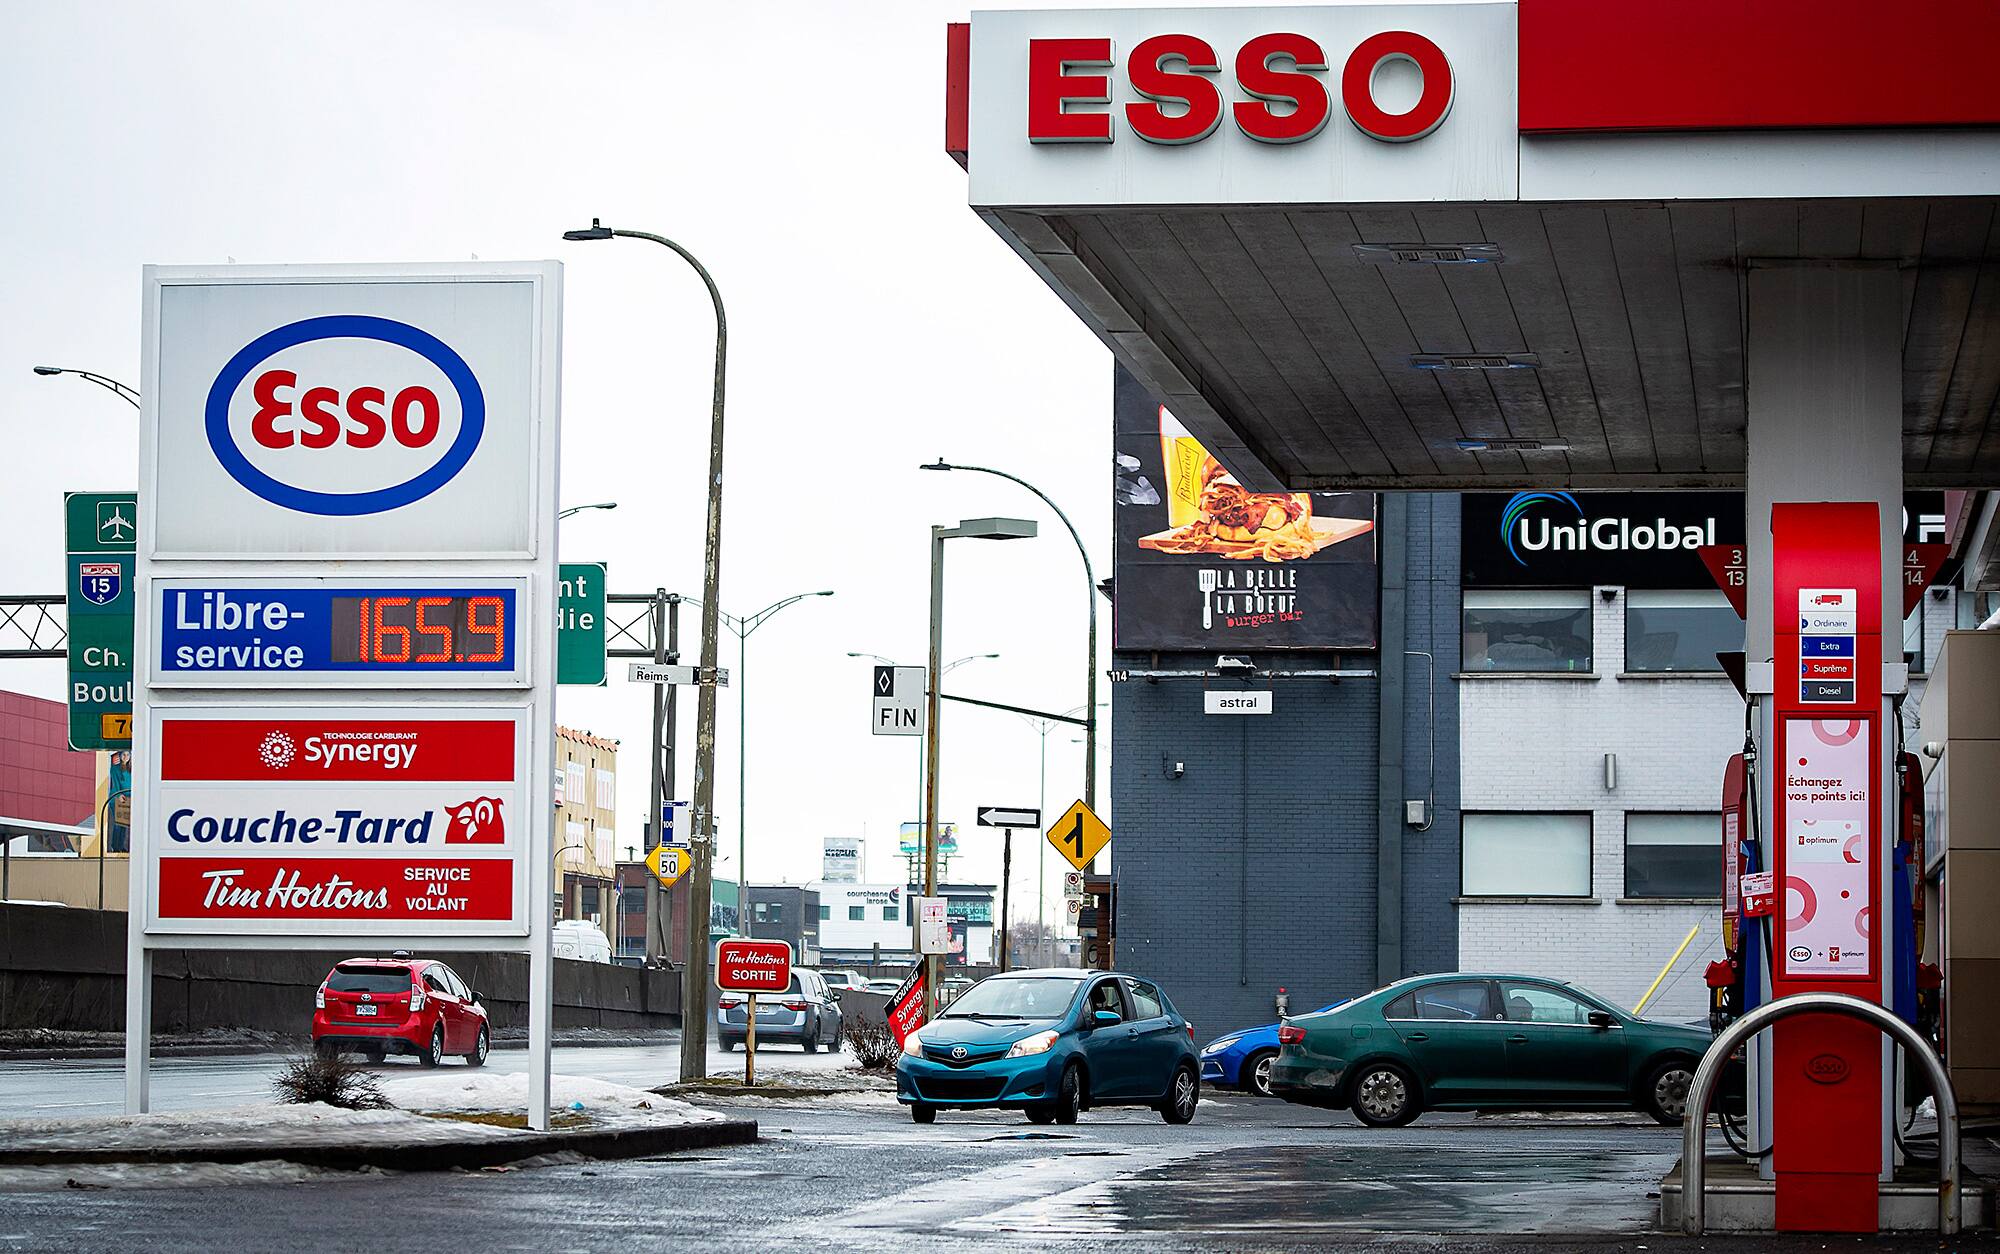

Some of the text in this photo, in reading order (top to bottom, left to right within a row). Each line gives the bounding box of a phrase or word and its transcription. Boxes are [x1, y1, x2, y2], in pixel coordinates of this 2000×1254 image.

[1028, 30, 1456, 145] ESSO
[251, 369, 440, 450] Esso
[1181, 447, 1192, 500] Budweiser
[1520, 517, 1716, 551] UniGlobal
[1731, 550, 1742, 565] 3
[1906, 549, 1919, 564] 4
[1217, 569, 1297, 588] LA BELLE
[1726, 570, 1745, 586] 13
[1904, 570, 1924, 585] 14
[91, 578, 111, 593] 15
[1253, 585, 1260, 597] &
[176, 591, 305, 630] Libre-
[1217, 595, 1297, 614] LA BOEUF
[1226, 609, 1304, 628] burger bar
[1813, 619, 1848, 628] Ordinaire
[359, 596, 504, 663] 165.9
[176, 638, 304, 668] service
[1820, 642, 1840, 651] Extra
[83, 647, 126, 667] Ch.
[636, 670, 670, 682] Reims
[1110, 670, 1127, 682] 114
[1813, 664, 1848, 674] Suprême
[1818, 686, 1841, 695] Diesel
[1219, 697, 1257, 708] astral
[881, 708, 917, 727] FIN
[114, 719, 132, 734] 7
[323, 732, 418, 740] TECHNOLOGIE CARBURANT
[304, 736, 418, 769] Synergy
[1788, 774, 1843, 790] Échangez
[1788, 790, 1866, 804] vos points ici!
[167, 808, 434, 844] Couche-Tard
[663, 820, 674, 829] 100
[1805, 836, 1838, 845] optimum
[404, 867, 471, 881] SERVICE
[661, 860, 677, 874] 50
[202, 867, 390, 909] Tim Hortons
[426, 883, 448, 895] AU
[405, 897, 469, 911] VOLANT
[866, 897, 889, 905] larose
[726, 950, 785, 965] Tim Hortons
[1792, 950, 1809, 958] Esso
[1841, 950, 1865, 958] optimum
[732, 969, 777, 981] SORTIE
[893, 970, 919, 1007] NOUVEAU
[896, 986, 924, 1023] Synergy
